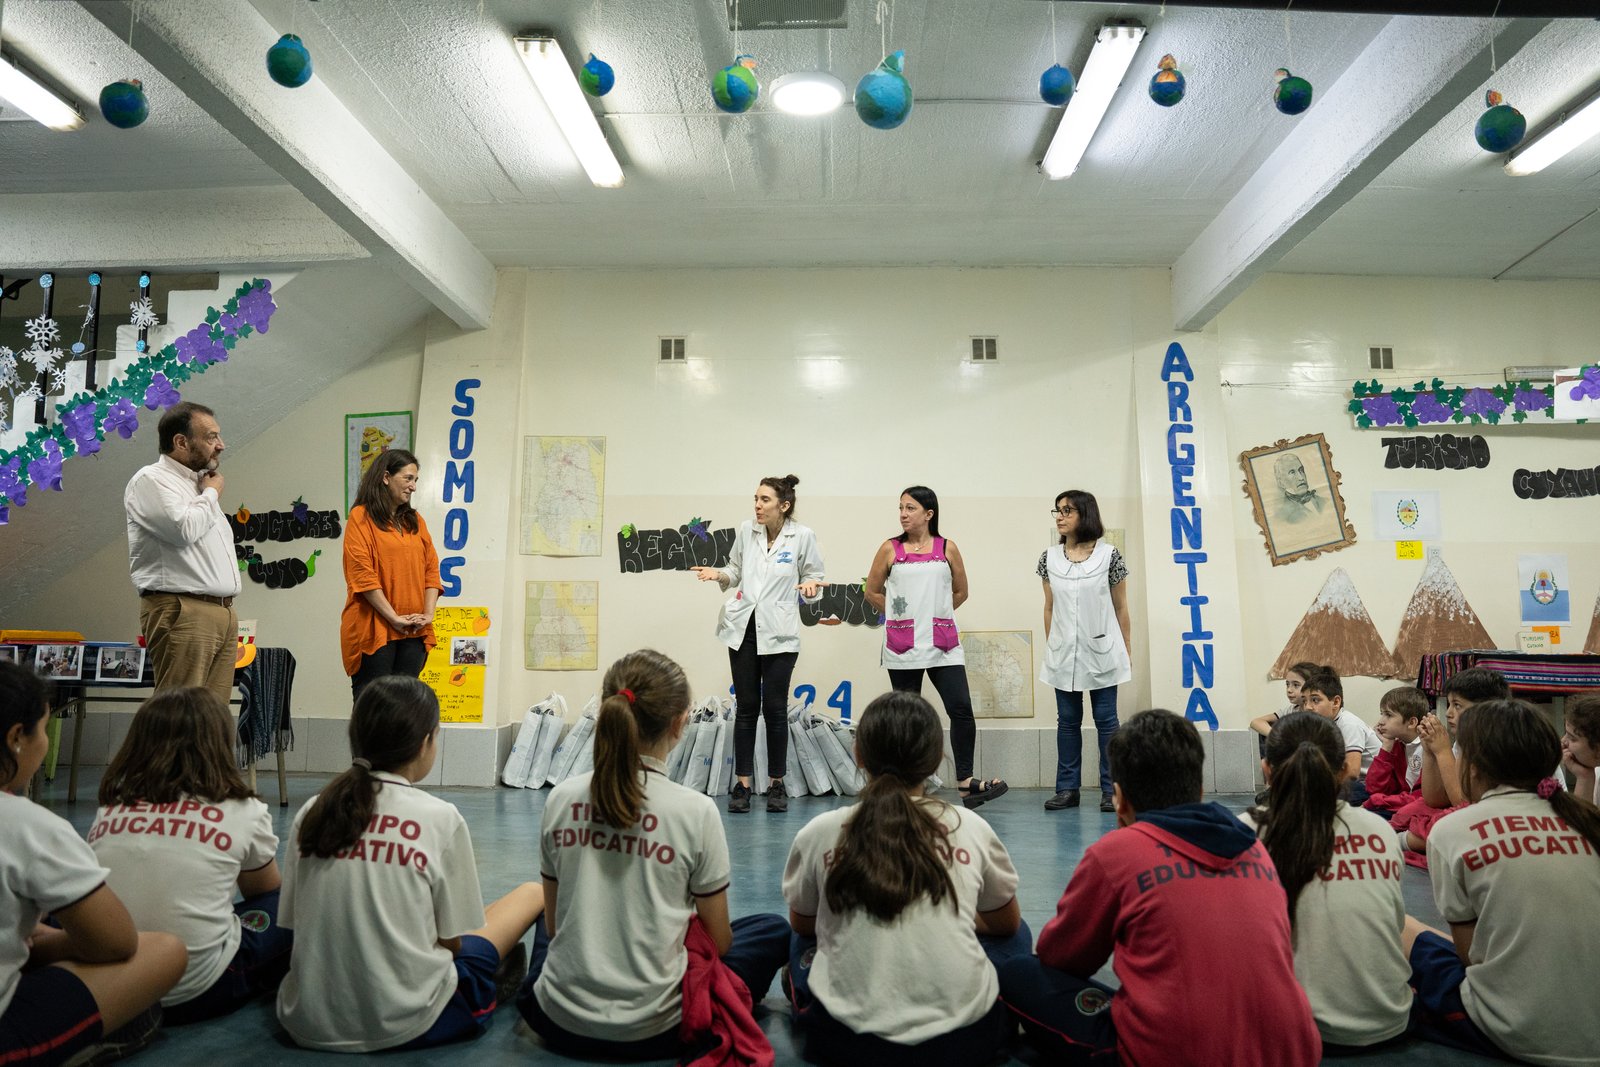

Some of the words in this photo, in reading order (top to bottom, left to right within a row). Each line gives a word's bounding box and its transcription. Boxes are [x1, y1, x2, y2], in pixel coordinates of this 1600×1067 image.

[440, 379, 481, 597] SOMOS
[1512, 465, 1600, 499] CUYAN
[226, 510, 342, 543] ODUCTORES
[1161, 342, 1219, 731] ARGENTINA
[433, 621, 468, 632] MELADA
[434, 608, 451, 621] ETA
[460, 609, 474, 619] DE
[87, 816, 232, 852] EDUCATIVO
[552, 828, 676, 865] EDUCATIVO
[1316, 859, 1401, 882] CATIVO
[1462, 835, 1592, 872] EDUCATI
[1137, 861, 1281, 893] EDUCATIV
